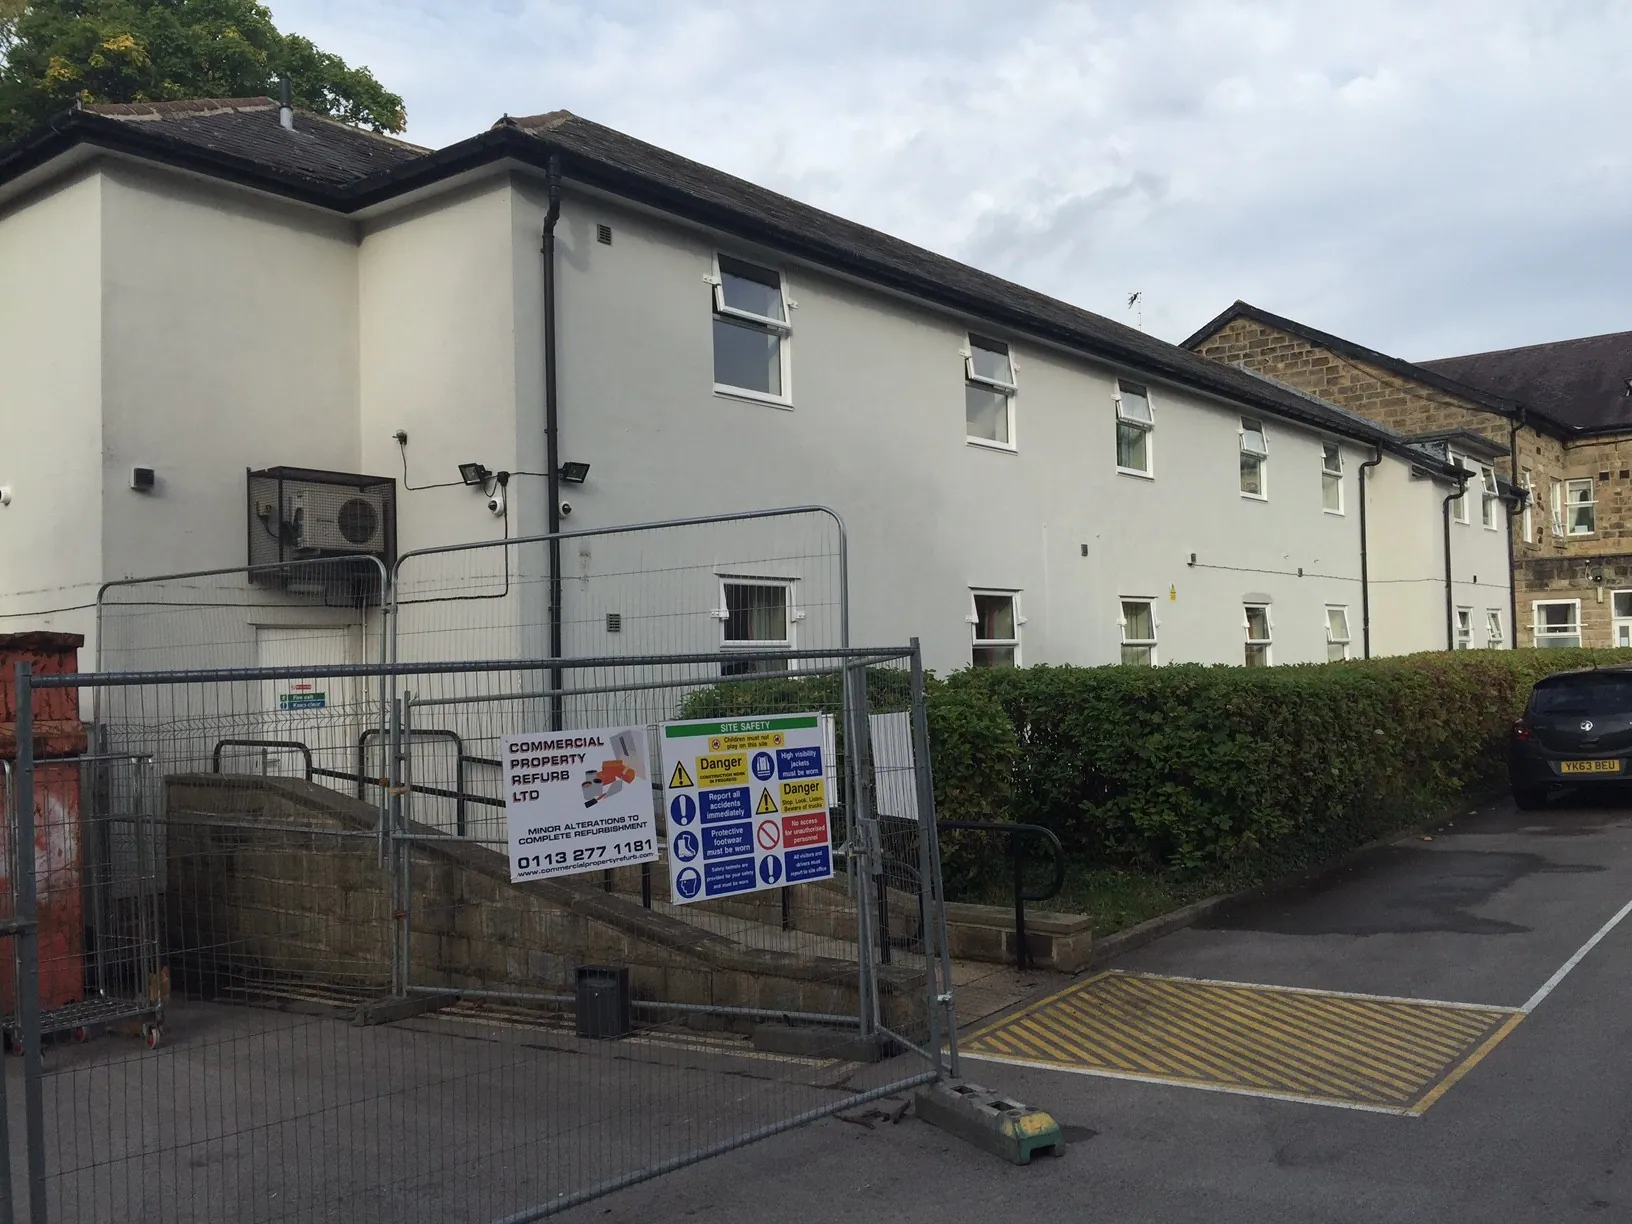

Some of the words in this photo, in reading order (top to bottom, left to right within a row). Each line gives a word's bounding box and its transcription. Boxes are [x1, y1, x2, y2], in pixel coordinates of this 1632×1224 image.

[720, 722, 738, 732] SITE
[741, 720, 770, 731] SAFETY
[509, 736, 605, 754] COMMERCIAL
[781, 751, 793, 760] High
[795, 750, 816, 758] visibility
[510, 752, 586, 770] PROPERTY
[700, 757, 742, 771] Danger
[791, 760, 809, 769] jackets
[1565, 761, 1592, 771] YK63
[1595, 760, 1615, 770] BEU
[512, 770, 570, 787] REFURB
[700, 772, 732, 780] CONSTRUCTION
[784, 782, 819, 796] Danger
[513, 789, 540, 804] LTD
[709, 792, 731, 801] Report
[710, 800, 741, 810] accidents
[784, 804, 801, 812] Beware
[707, 808, 745, 819] immediately
[528, 824, 561, 835] MINOR
[564, 817, 626, 830] ALTERATIONS
[628, 814, 639, 822] TO
[800, 818, 817, 826] access
[518, 832, 571, 845] COMPLETE
[574, 821, 648, 838] REFURBISHMENT
[711, 828, 743, 837] Protective
[793, 824, 826, 834] unauthorised
[714, 837, 742, 846] footwear
[793, 834, 818, 844] personnel
[518, 851, 567, 869] 0113
[573, 846, 607, 861] 277
[614, 839, 652, 855] 1181
[707, 848, 723, 856] must
[518, 852, 654, 878] www.commercialpropertyrefurb.com
[707, 873, 724, 882] provided
